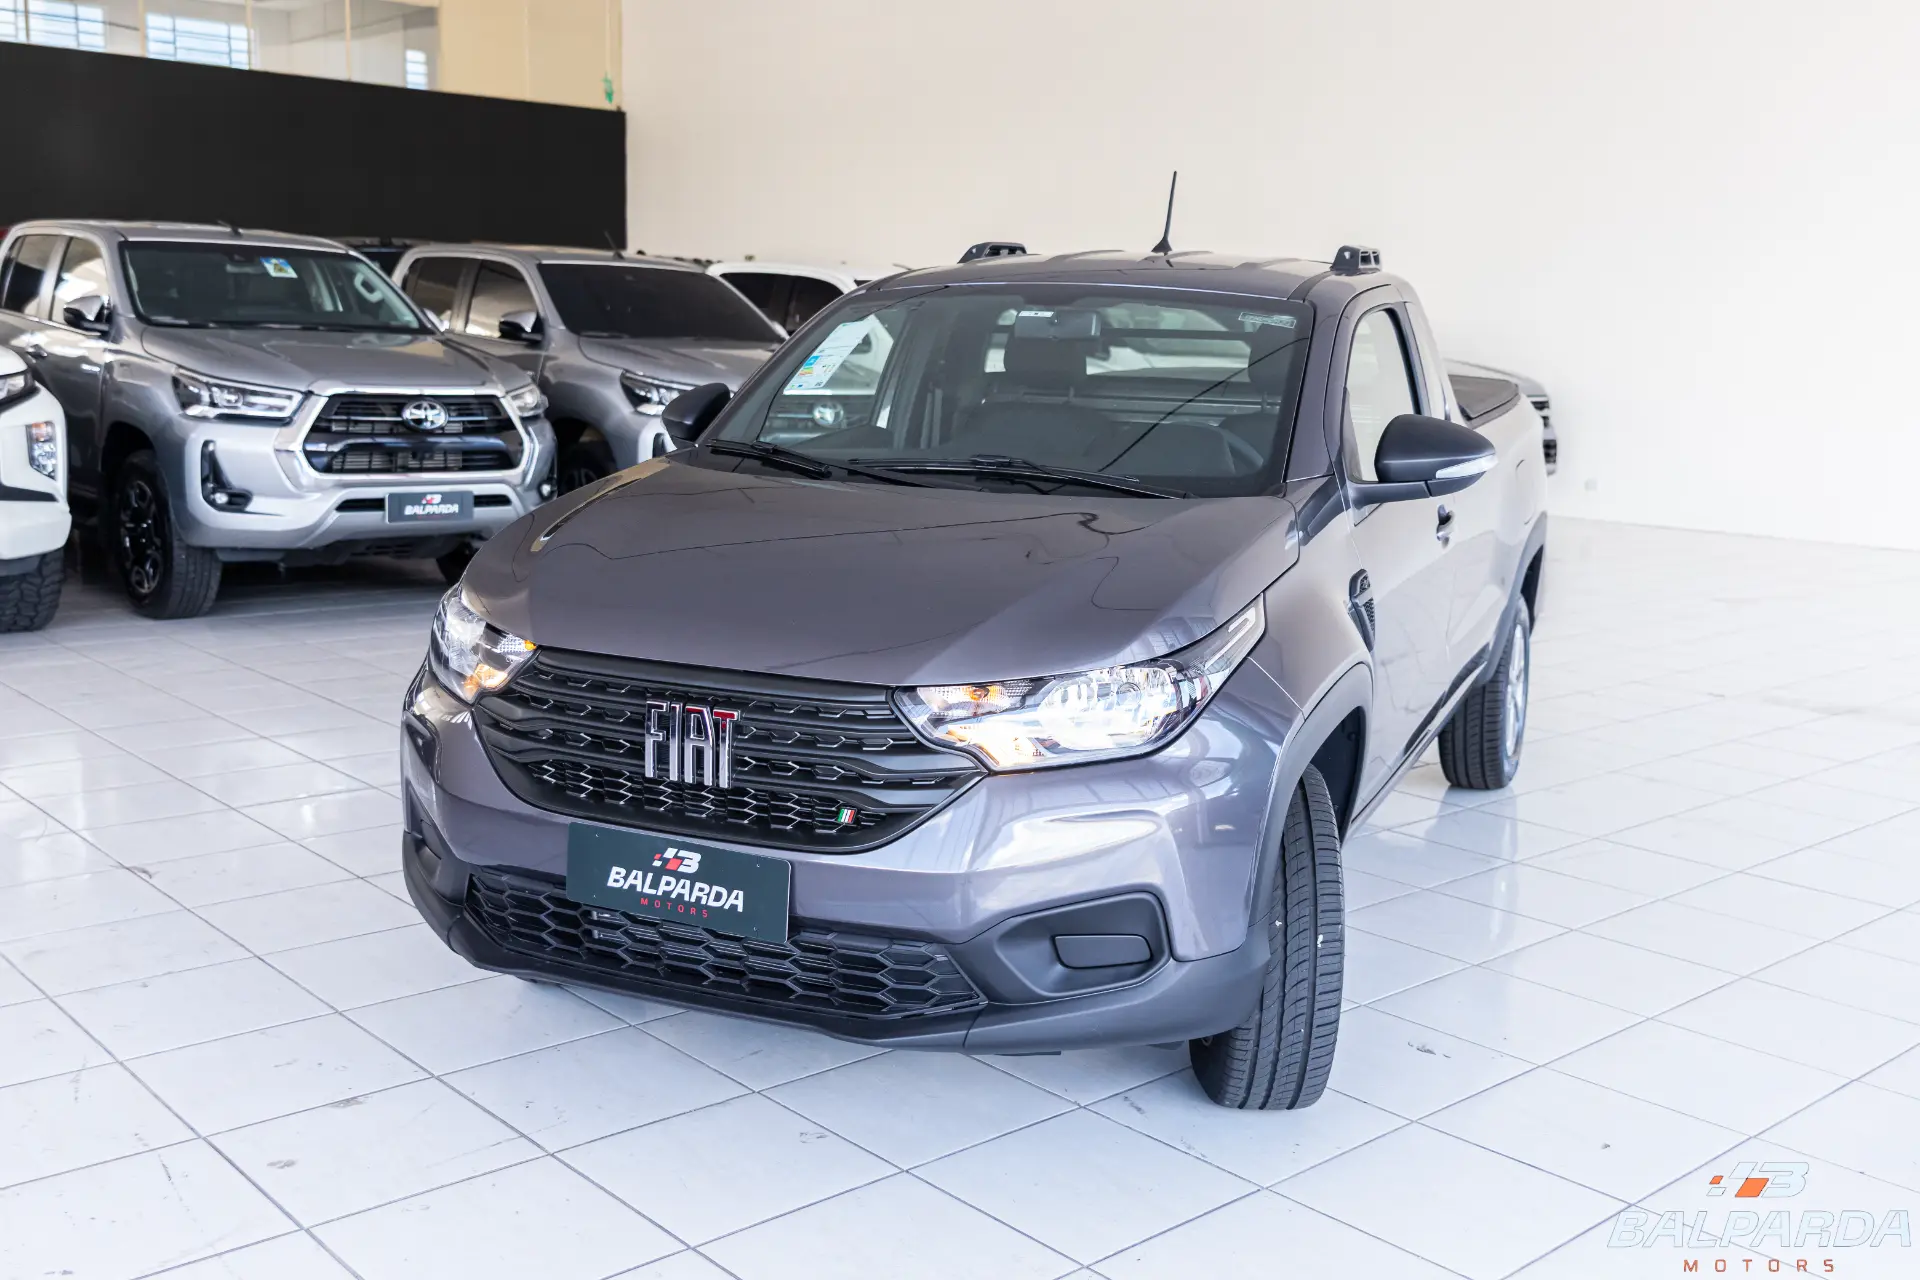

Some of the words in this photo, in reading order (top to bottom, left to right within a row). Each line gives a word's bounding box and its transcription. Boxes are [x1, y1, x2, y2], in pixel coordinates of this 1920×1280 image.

[404, 503, 459, 515] BALPARDA
[645, 700, 741, 789] FIAT
[606, 866, 744, 913] BALPARDA
[640, 897, 709, 918] MOTORS
